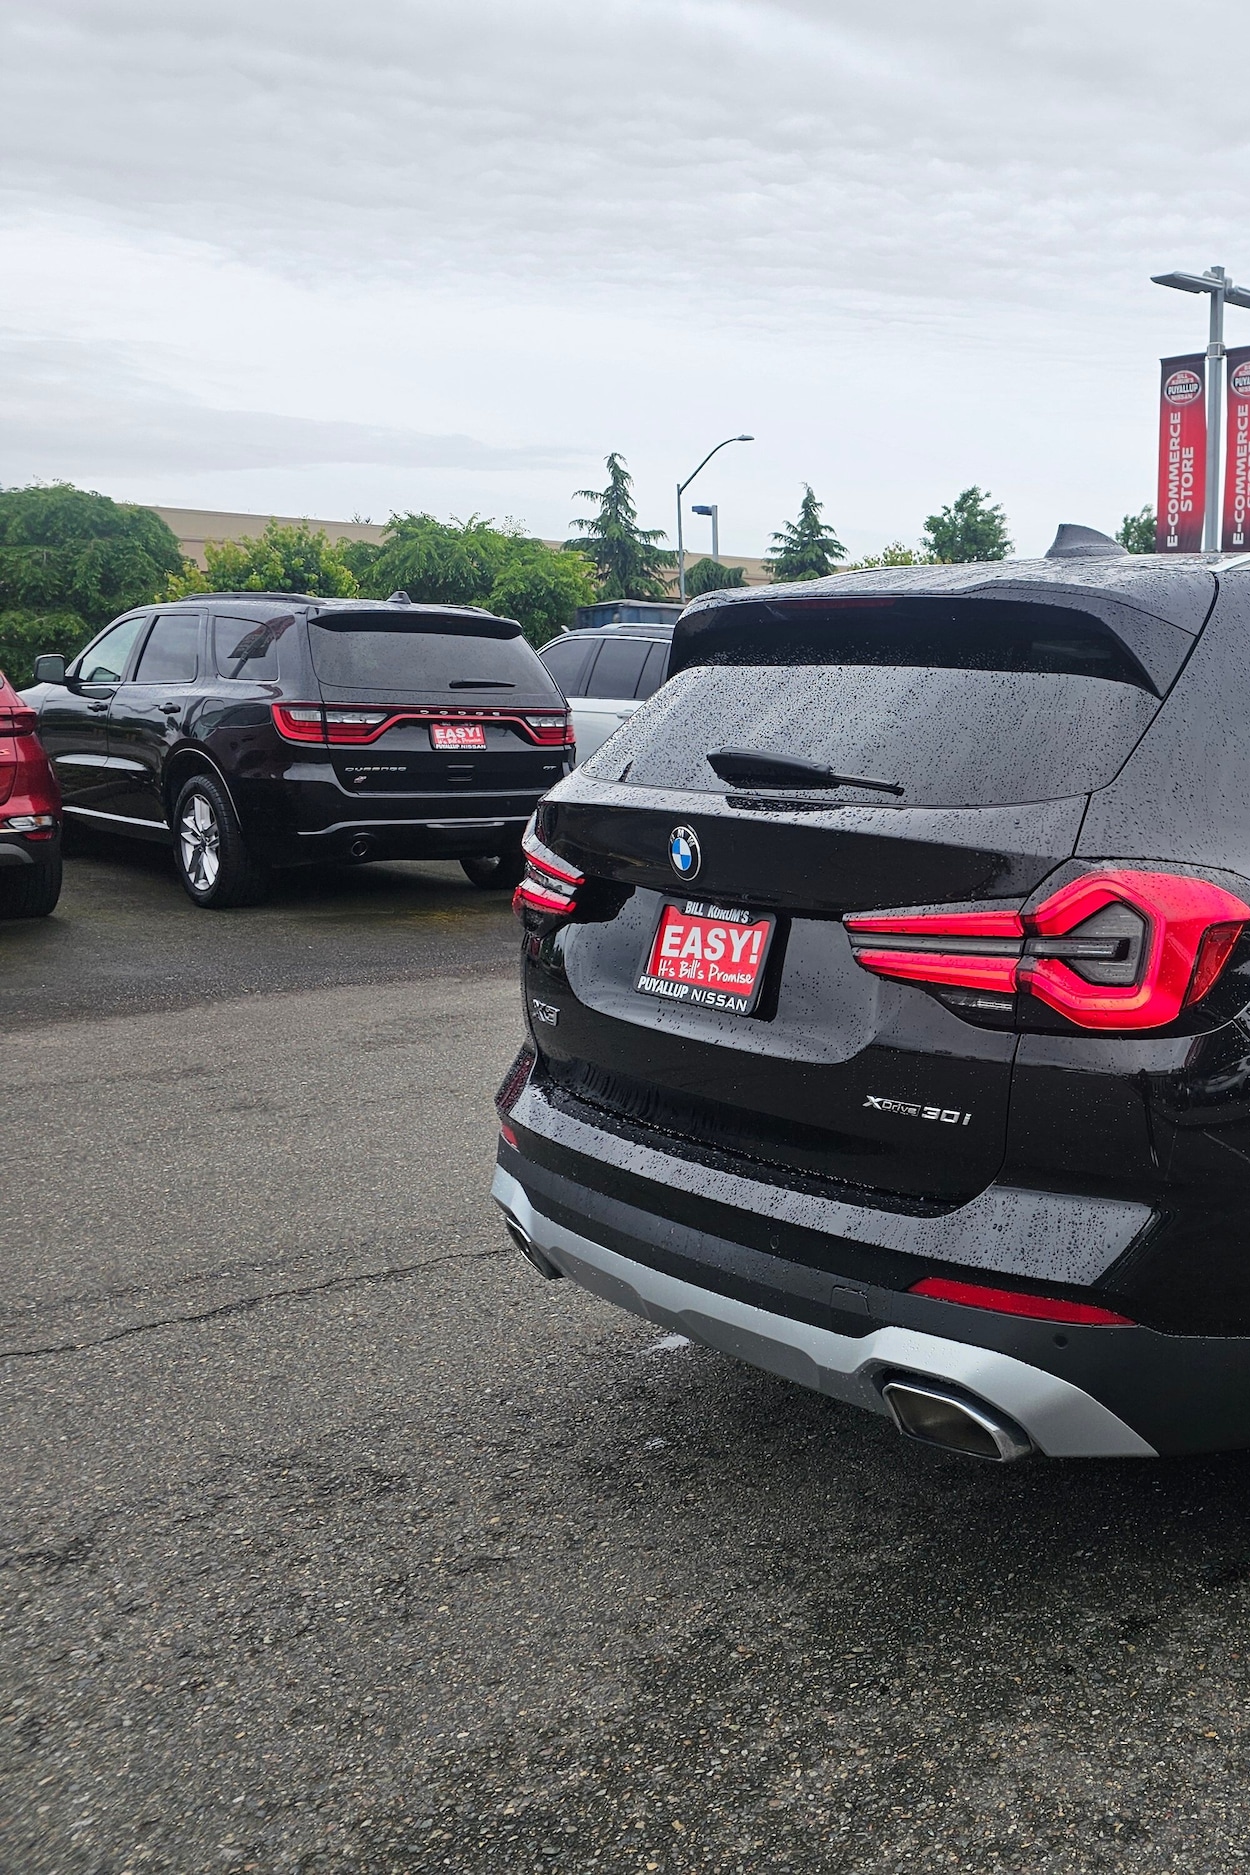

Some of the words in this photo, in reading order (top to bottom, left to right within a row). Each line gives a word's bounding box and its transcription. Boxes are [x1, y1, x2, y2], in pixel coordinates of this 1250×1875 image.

[1168, 383, 1198, 395] PUYALLUP
[1166, 411, 1181, 548] E-COMMERCE
[1180, 446, 1194, 512] STORE
[1232, 404, 1249, 545] E-COMMERCE
[434, 727, 481, 739] EASY!
[684, 900, 704, 916] BILL
[707, 904, 750, 924] KORUM'S
[660, 924, 762, 964] EASY!
[657, 958, 676, 977] It's
[678, 959, 705, 979] Bill's
[708, 963, 754, 985] Promise
[637, 975, 689, 998] PUYALLUP
[690, 988, 747, 1012] NISSAN
